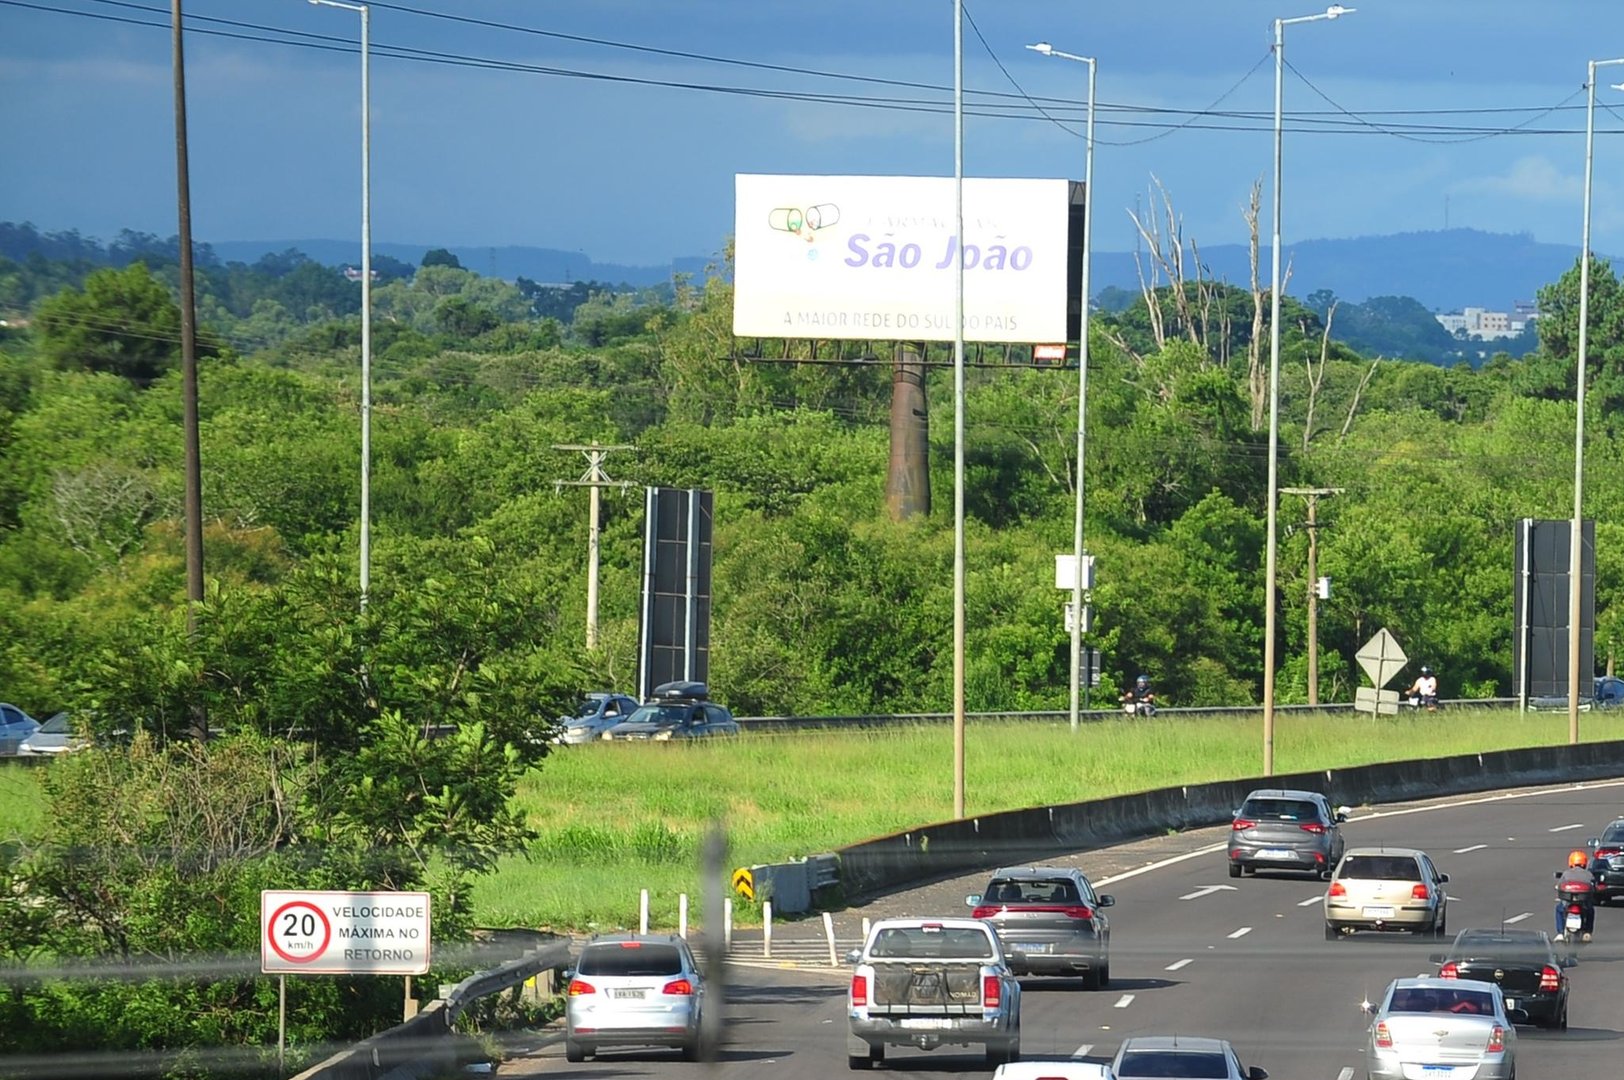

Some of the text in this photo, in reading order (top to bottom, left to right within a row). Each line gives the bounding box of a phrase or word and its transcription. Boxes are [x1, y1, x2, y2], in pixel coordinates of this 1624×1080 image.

[844, 233, 1034, 272] São João
[783, 311, 793, 326] A
[796, 311, 848, 326] MAIOR
[853, 312, 891, 328] REDE
[896, 313, 920, 329] DO
[923, 314, 952, 330] SUL
[332, 906, 425, 918] VELOCIDADE
[283, 913, 316, 937] 20
[338, 925, 420, 939] MÁXIMA NO
[287, 940, 314, 950] km/h
[344, 949, 414, 961] RETORNO
